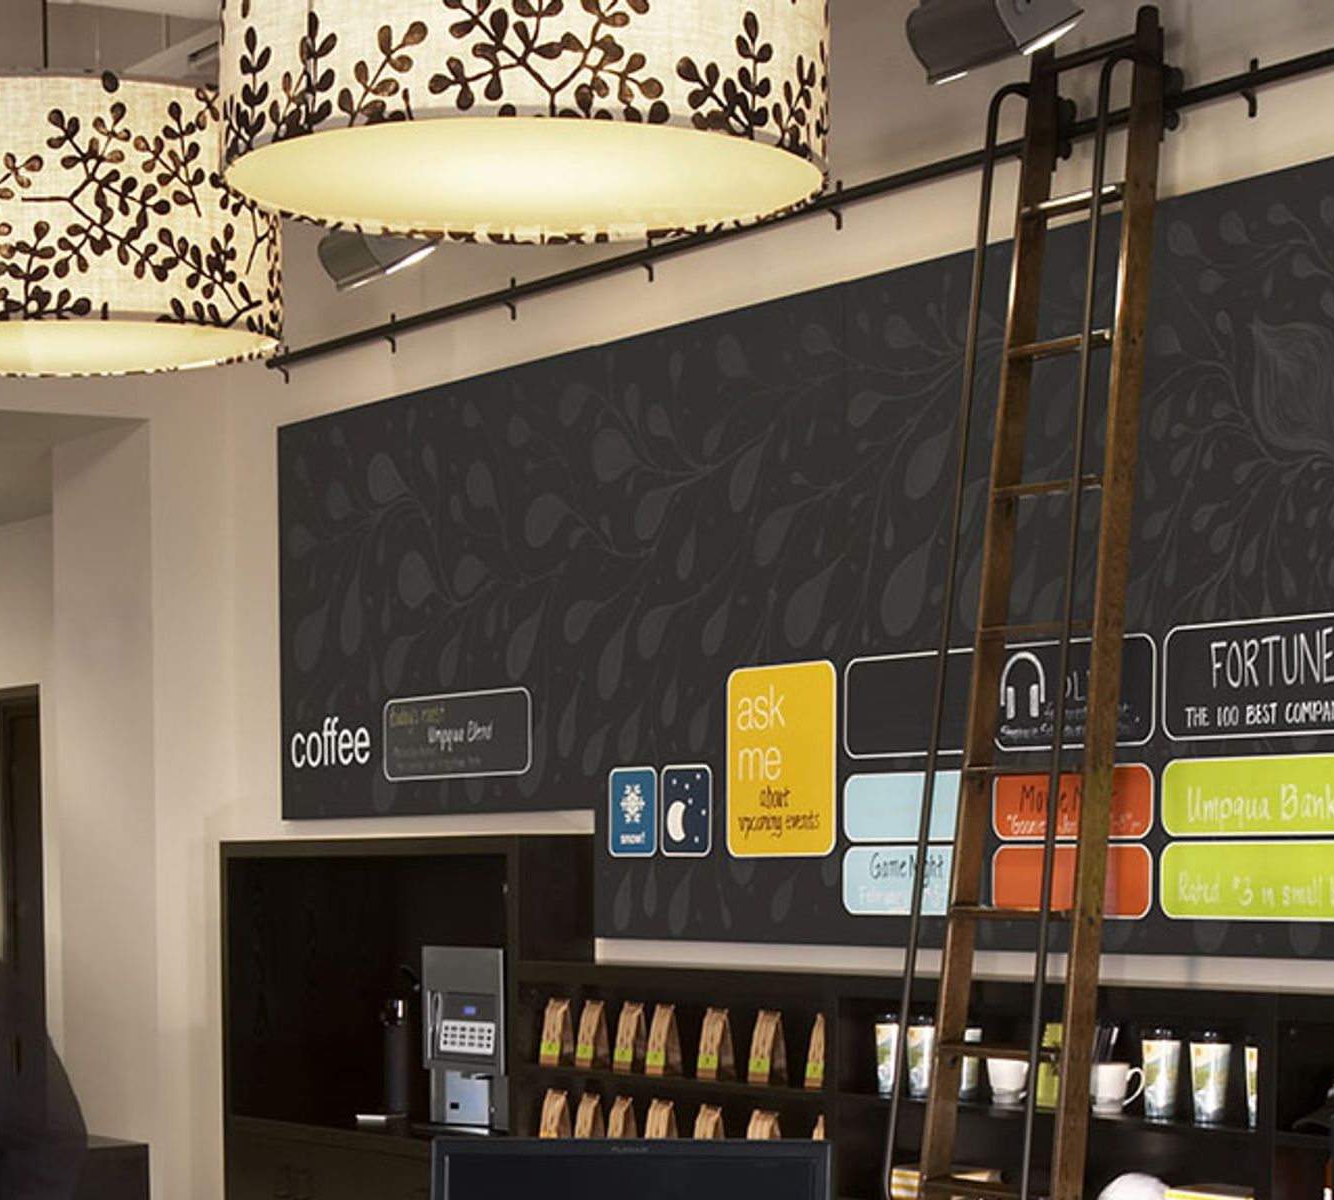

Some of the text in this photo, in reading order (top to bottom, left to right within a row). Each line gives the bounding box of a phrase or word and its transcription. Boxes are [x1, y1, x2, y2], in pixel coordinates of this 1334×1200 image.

[736, 684, 786, 732] ask
[1184, 706, 1210, 728] THE
[1216, 705, 1240, 727] 100
[1245, 702, 1278, 726] BEST
[291, 717, 371, 768] coffee
[737, 747, 783, 782] me
[759, 785, 792, 809] about
[1186, 785, 1272, 829] Umpqua
[784, 811, 821, 831] events
[1177, 870, 1220, 904] Rated
[1261, 886, 1277, 909] in
[1281, 876, 1324, 908] small
